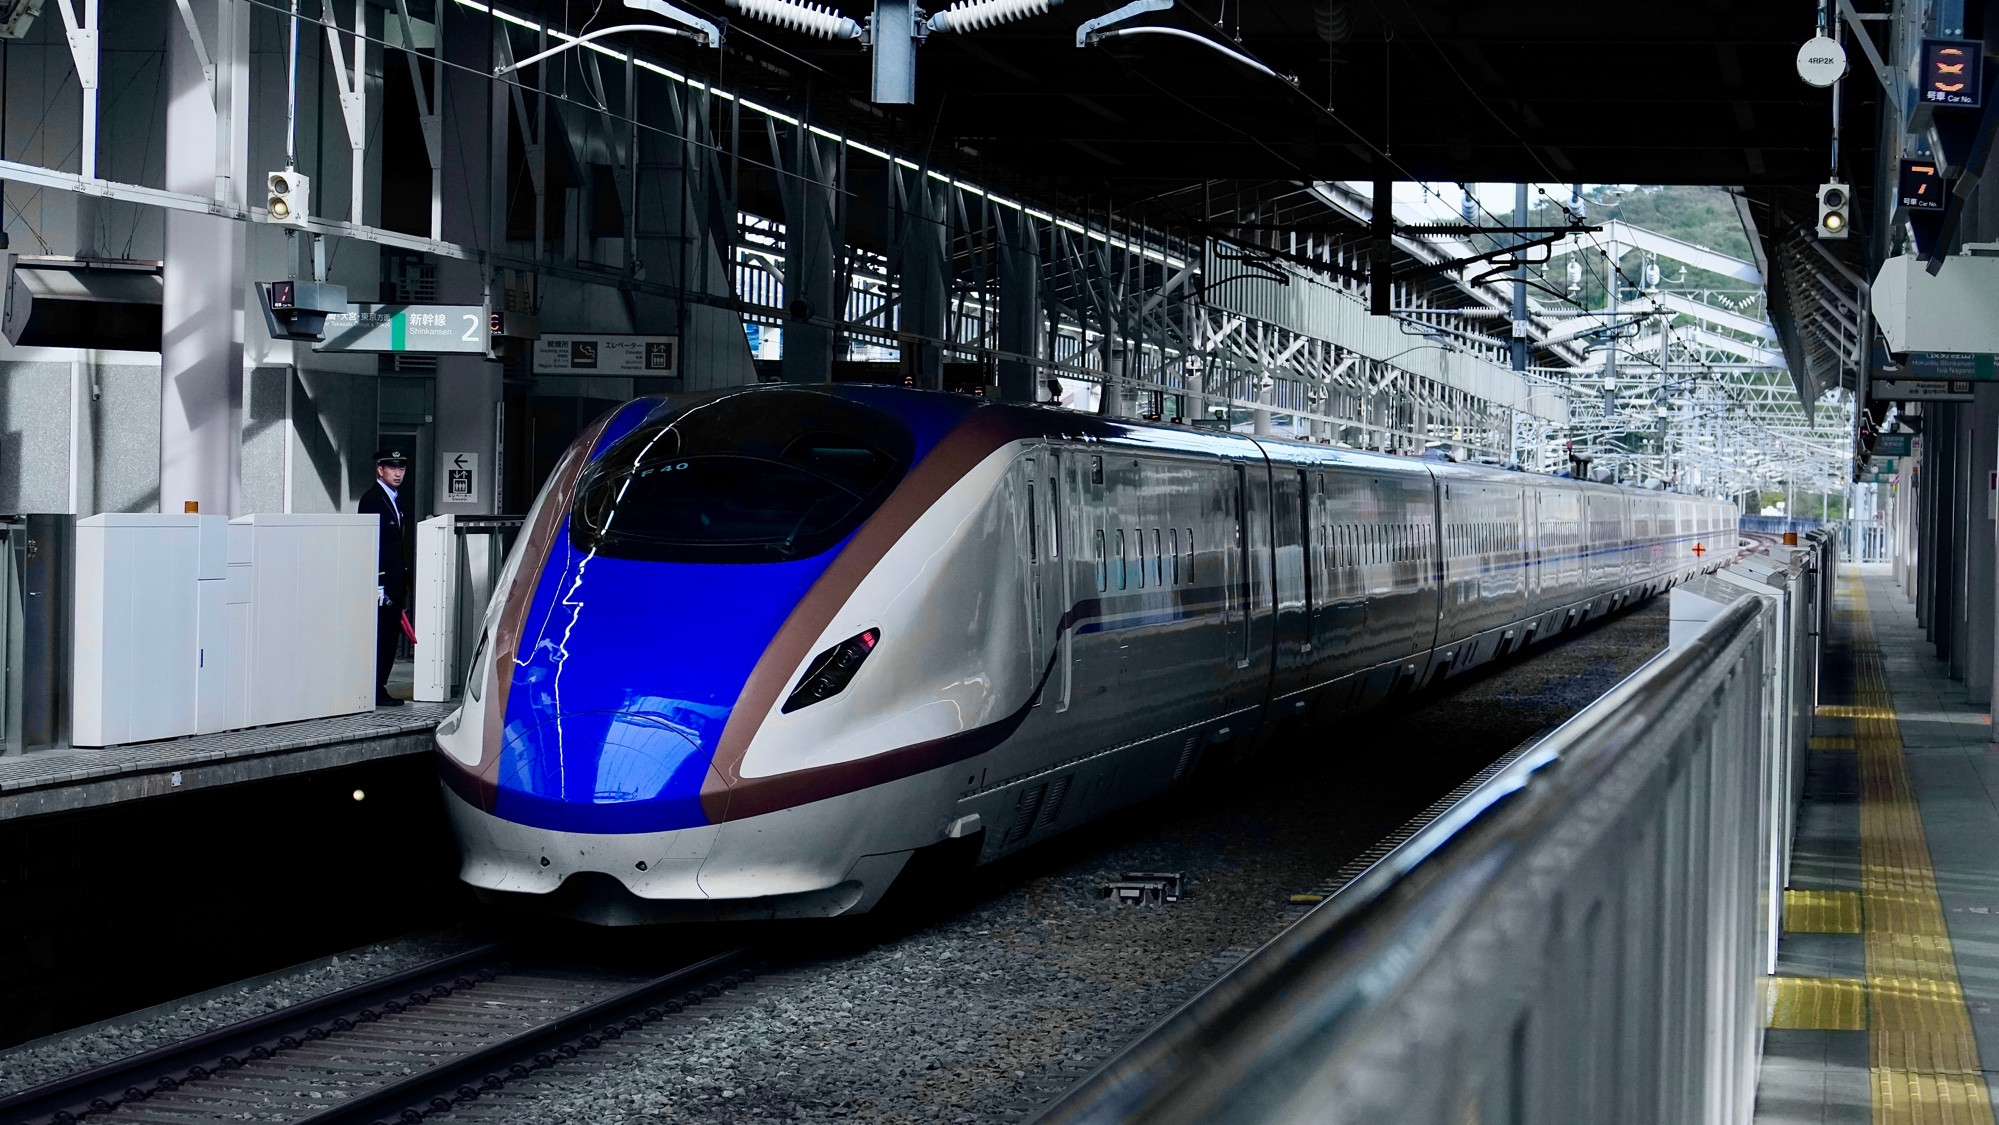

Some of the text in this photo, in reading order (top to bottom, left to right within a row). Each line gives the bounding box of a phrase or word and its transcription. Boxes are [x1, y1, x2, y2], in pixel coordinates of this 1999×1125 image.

[1808, 57, 1835, 65] 4RP2K
[1926, 90, 1974, 104] 号車 Car No.
[409, 313, 446, 326] 新幹線
[461, 314, 479, 342] 2
[409, 328, 452, 336] Shinkansen
[605, 341, 644, 349] エレベーター
